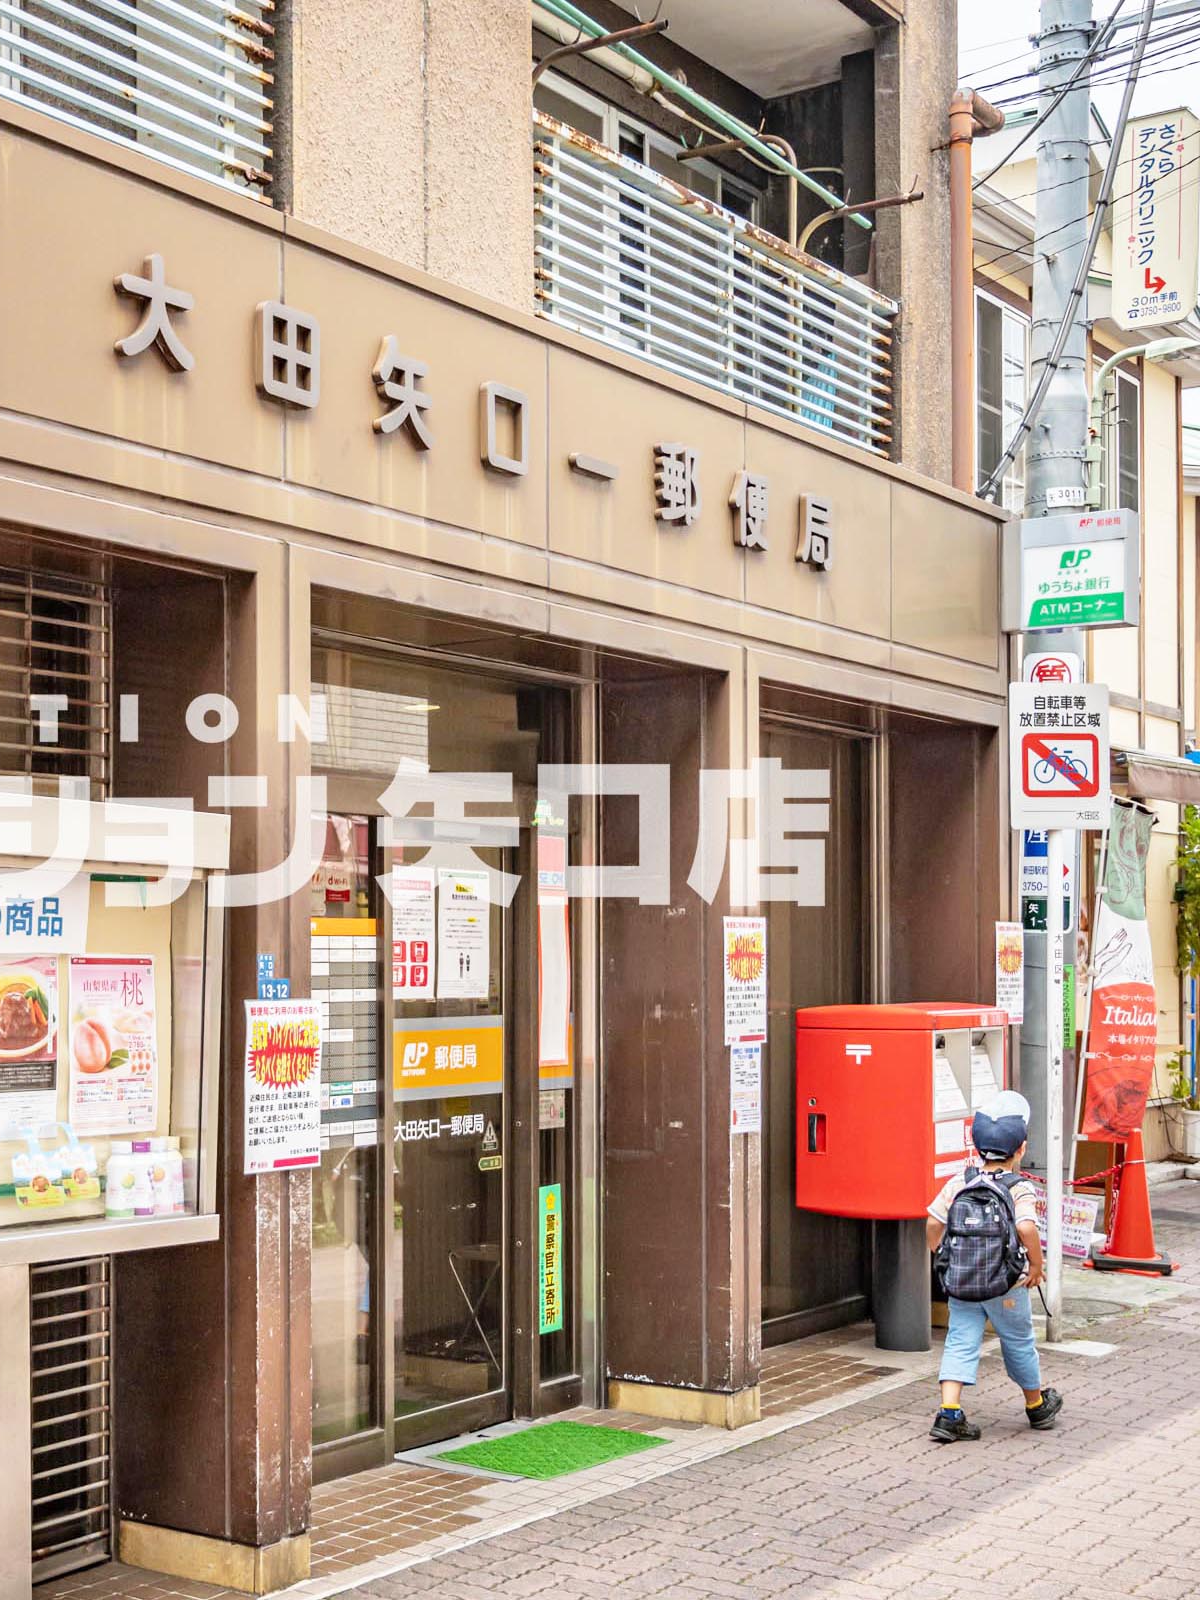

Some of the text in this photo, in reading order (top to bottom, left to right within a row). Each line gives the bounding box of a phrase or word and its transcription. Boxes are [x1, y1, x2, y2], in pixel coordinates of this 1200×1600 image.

[1158, 123, 1176, 173] さくら
[1138, 127, 1157, 265] デンタルクリニック
[113, 252, 834, 573] 大田矢口一郵便局
[1038, 576, 1110, 595] ゆうちょ銀行
[1039, 599, 1118, 616] ATMコーナー
[1033, 695, 1087, 710] 自転車等
[1019, 712, 1101, 728] 放置禁止区域
[1075, 810, 1100, 821] 大田区
[83, 979, 119, 993] 山梨県産
[120, 970, 144, 1007] 桃
[261, 983, 288, 998] 13-12
[434, 1043, 477, 1070] 郵便局
[393, 1113, 485, 1142] 大田矢口一郵便局
